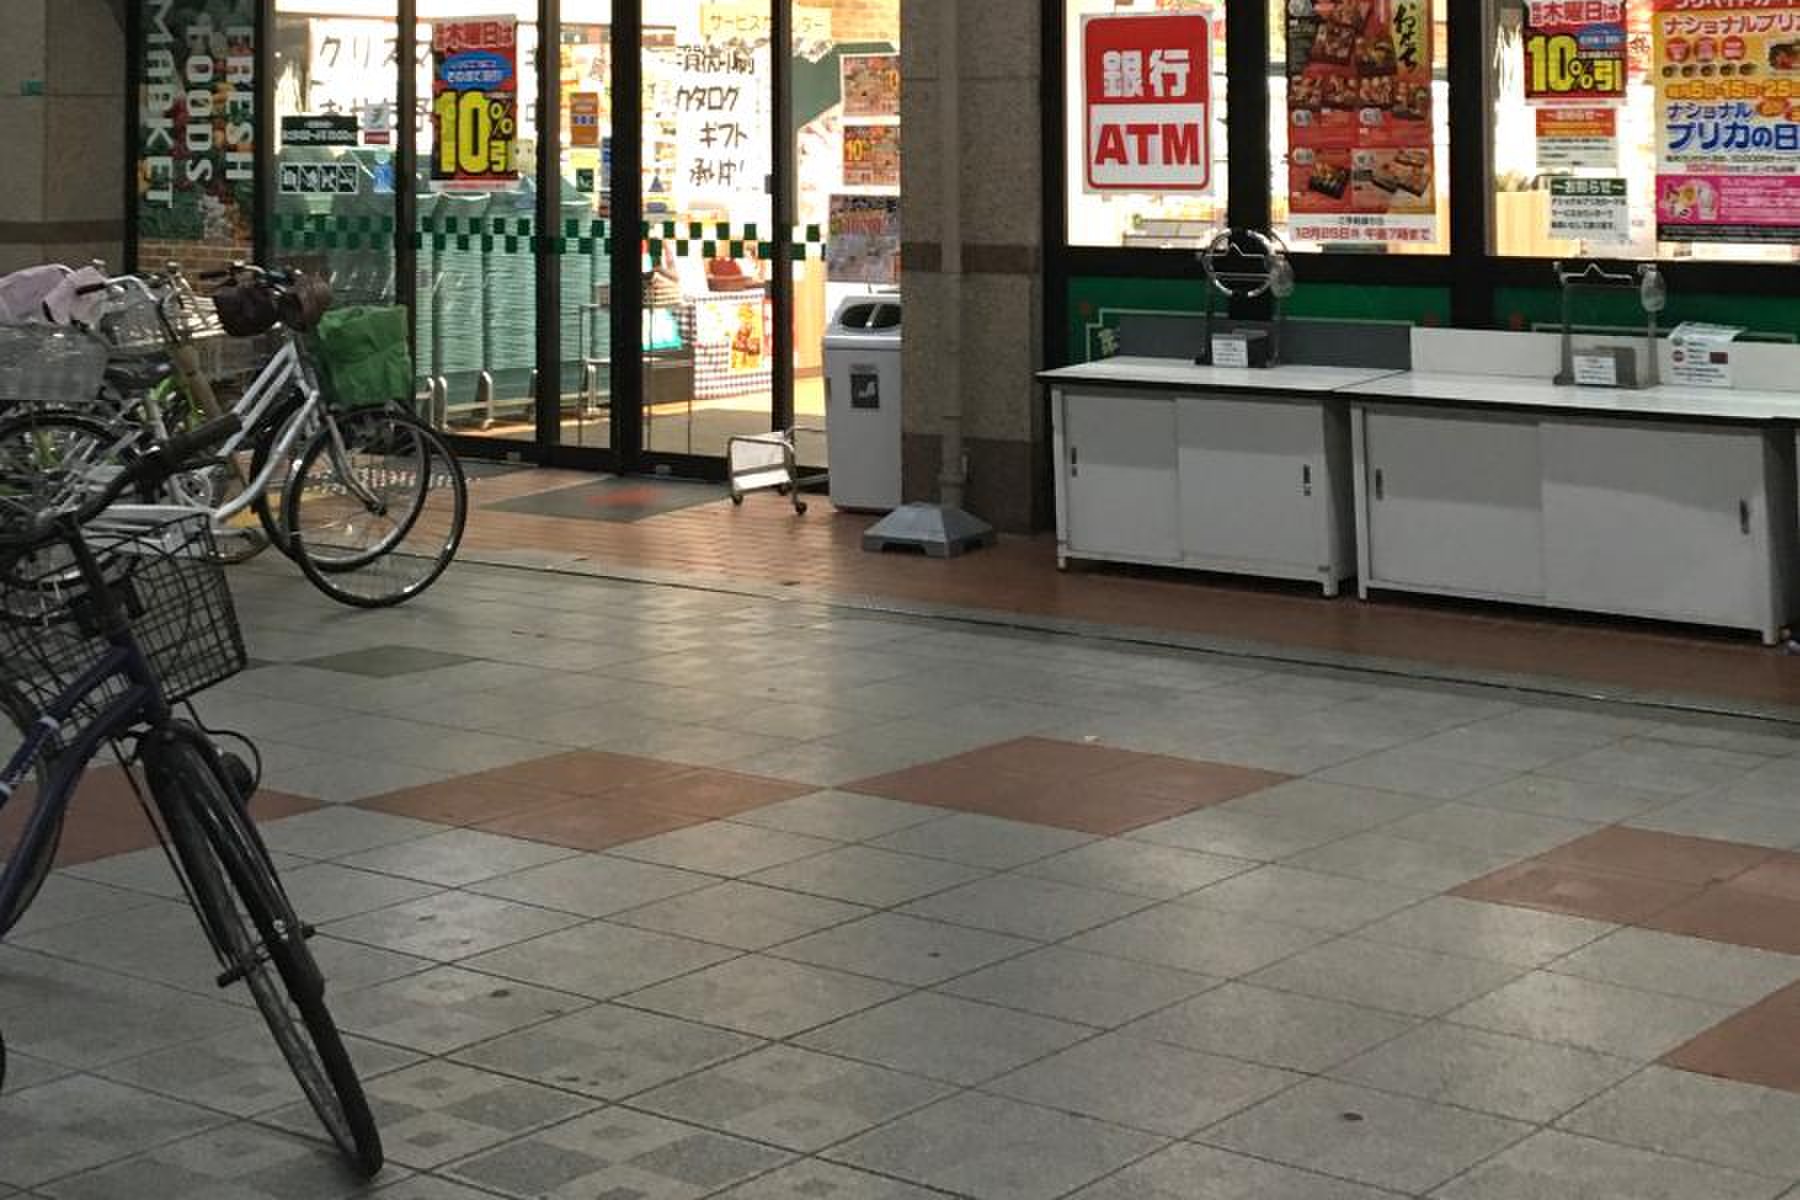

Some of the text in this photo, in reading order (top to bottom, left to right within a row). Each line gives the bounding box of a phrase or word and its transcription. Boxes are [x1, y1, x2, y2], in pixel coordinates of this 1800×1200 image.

[1103, 48, 1191, 98] 銀行
[1528, 35, 1622, 92] 10%引
[146, 0, 174, 209] MARKET
[185, 24, 212, 182] FOODS
[225, 26, 254, 180] FRESH
[675, 85, 740, 112] カタログ
[1667, 101, 1752, 119] ナショナル
[699, 121, 748, 149] ギフト
[1094, 123, 1200, 166] ATM
[1666, 121, 1798, 150] プリカの日
